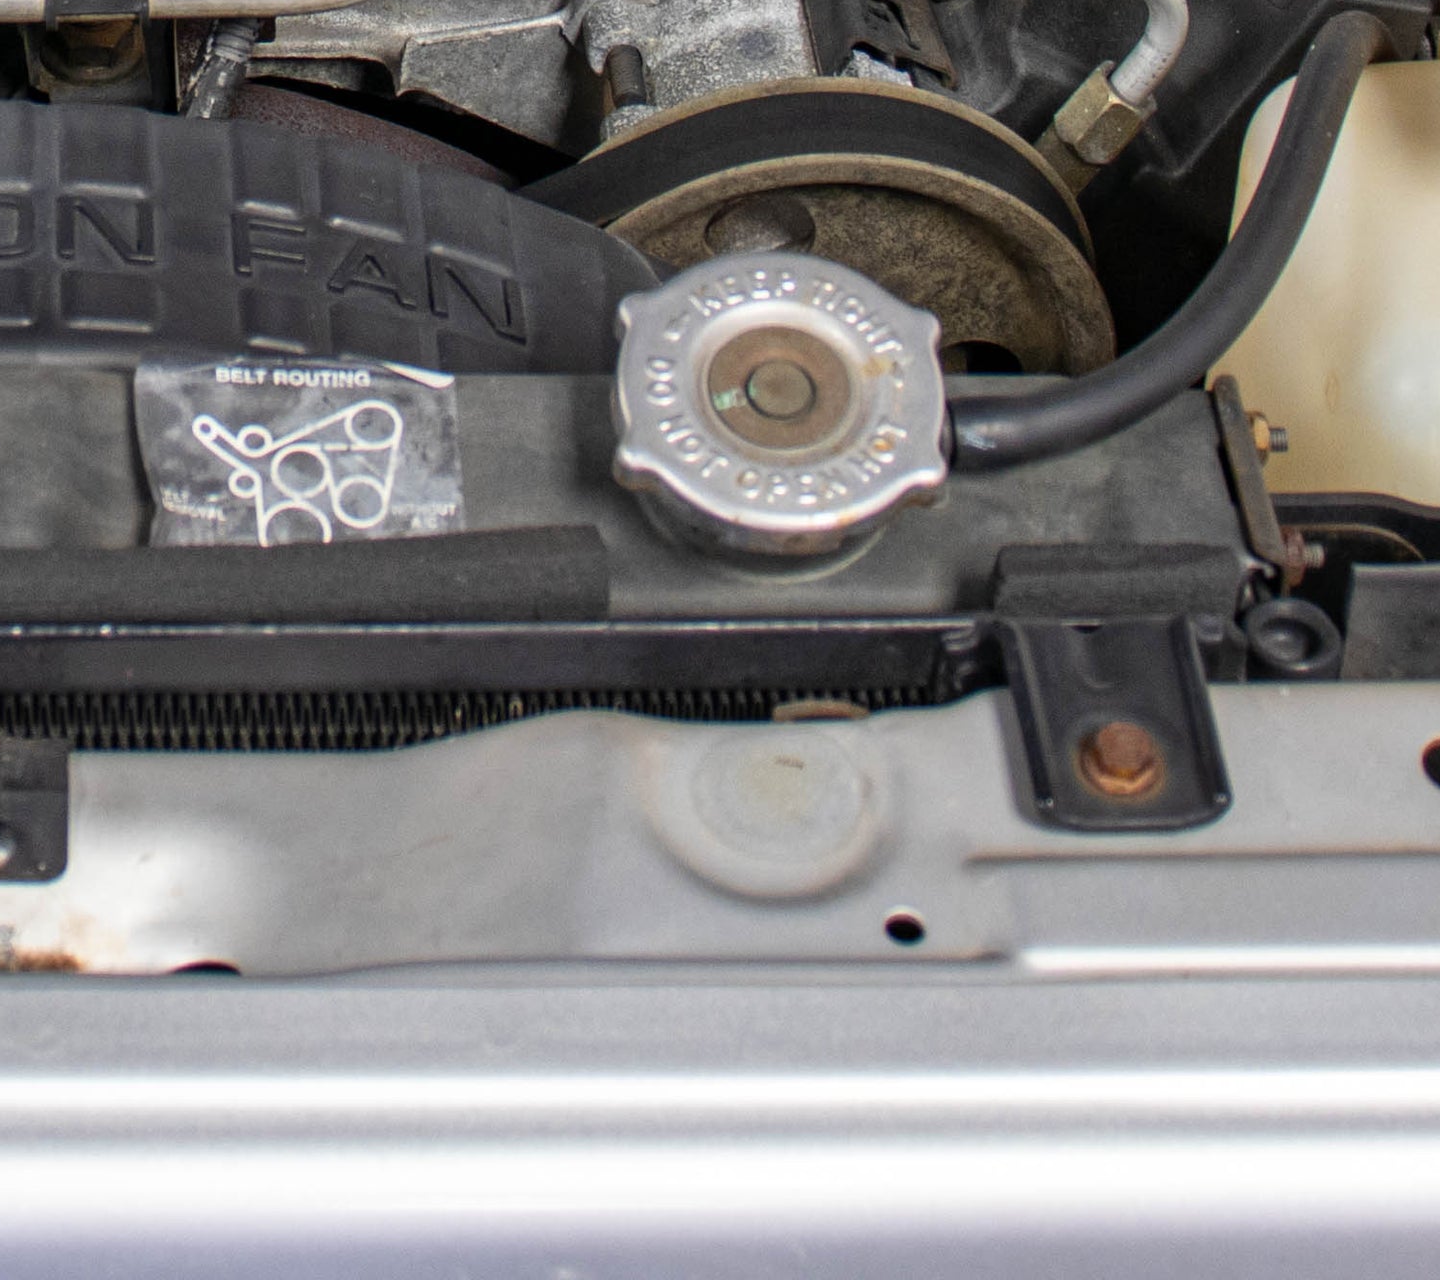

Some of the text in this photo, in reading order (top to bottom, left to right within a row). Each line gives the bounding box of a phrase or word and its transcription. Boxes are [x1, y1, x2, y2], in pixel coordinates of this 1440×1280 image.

[229, 208, 526, 345] FAN
[686, 268, 799, 318] KEEP
[216, 367, 371, 389] BELT ROUTING
